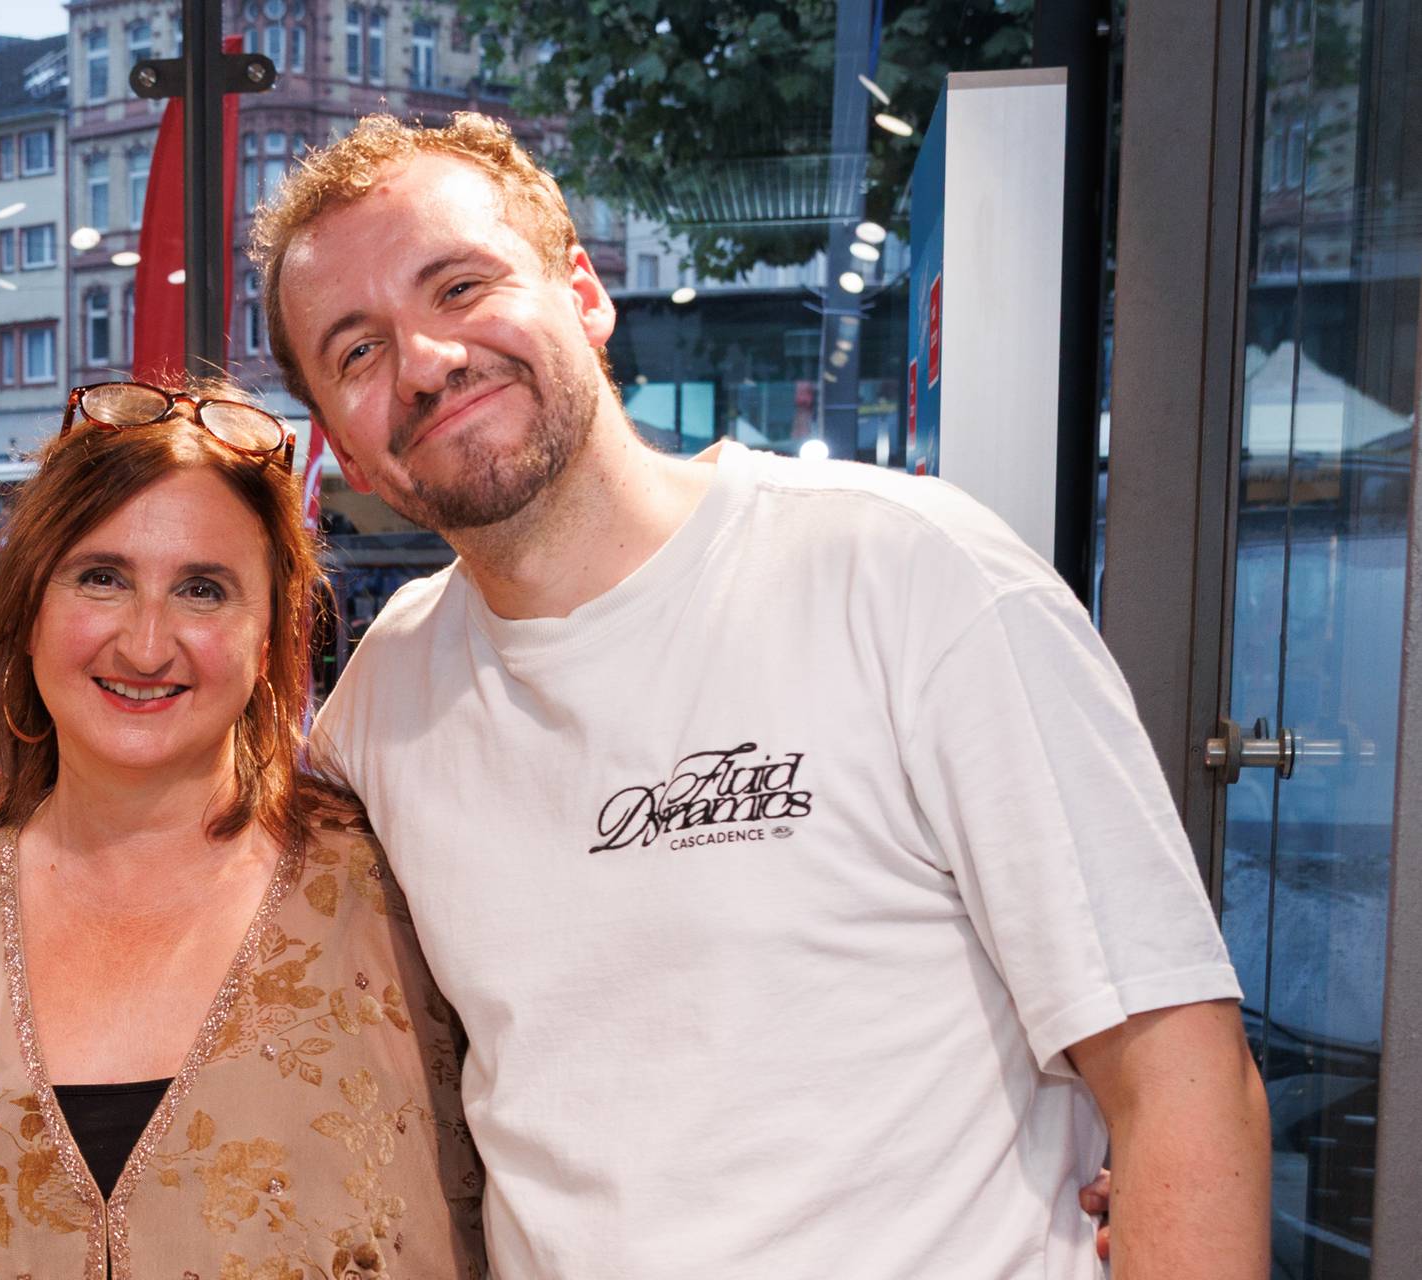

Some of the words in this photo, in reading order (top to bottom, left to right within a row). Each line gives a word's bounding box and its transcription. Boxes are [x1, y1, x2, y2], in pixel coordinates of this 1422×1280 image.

[661, 742, 805, 802] Fluid
[588, 782, 813, 854] Dynamics
[670, 828, 766, 852] CASCADENCE
